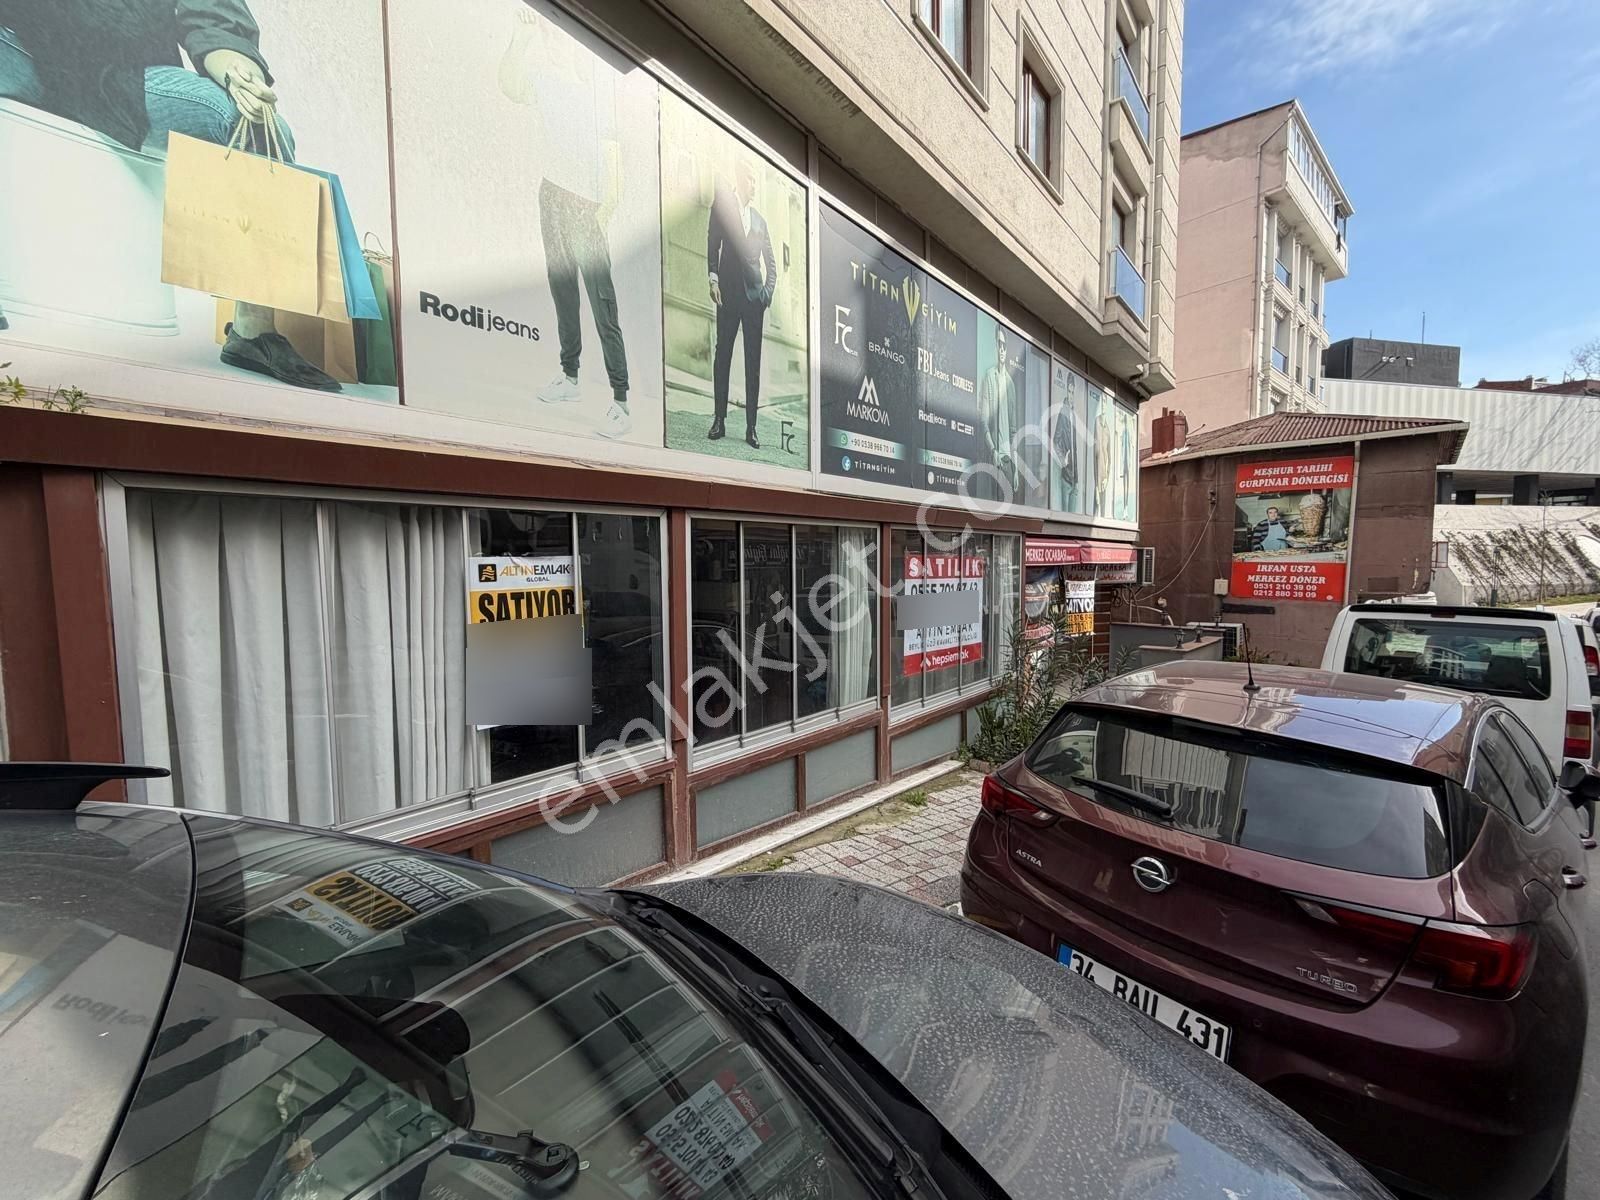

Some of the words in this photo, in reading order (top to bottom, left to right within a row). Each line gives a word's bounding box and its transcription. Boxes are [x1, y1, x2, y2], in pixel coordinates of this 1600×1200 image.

[851, 261, 899, 303] TİTAN
[921, 303, 957, 336] GİYİM
[868, 341, 905, 365] BRANGO
[846, 400, 890, 427] MARKOVA
[1025, 547, 1045, 562] MERKEZ
[908, 557, 981, 578] SATILIK
[1247, 574, 1287, 582] MERKEZ
[1289, 565, 1317, 573] USTA
[478, 589, 576, 623] SATIYOR
[931, 649, 969, 667] hepsiemak
[1015, 849, 1042, 868] ASTRA
[1295, 966, 1358, 993] TURBO
[1072, 953, 1096, 983] 34
[1176, 1009, 1225, 1059] 431
